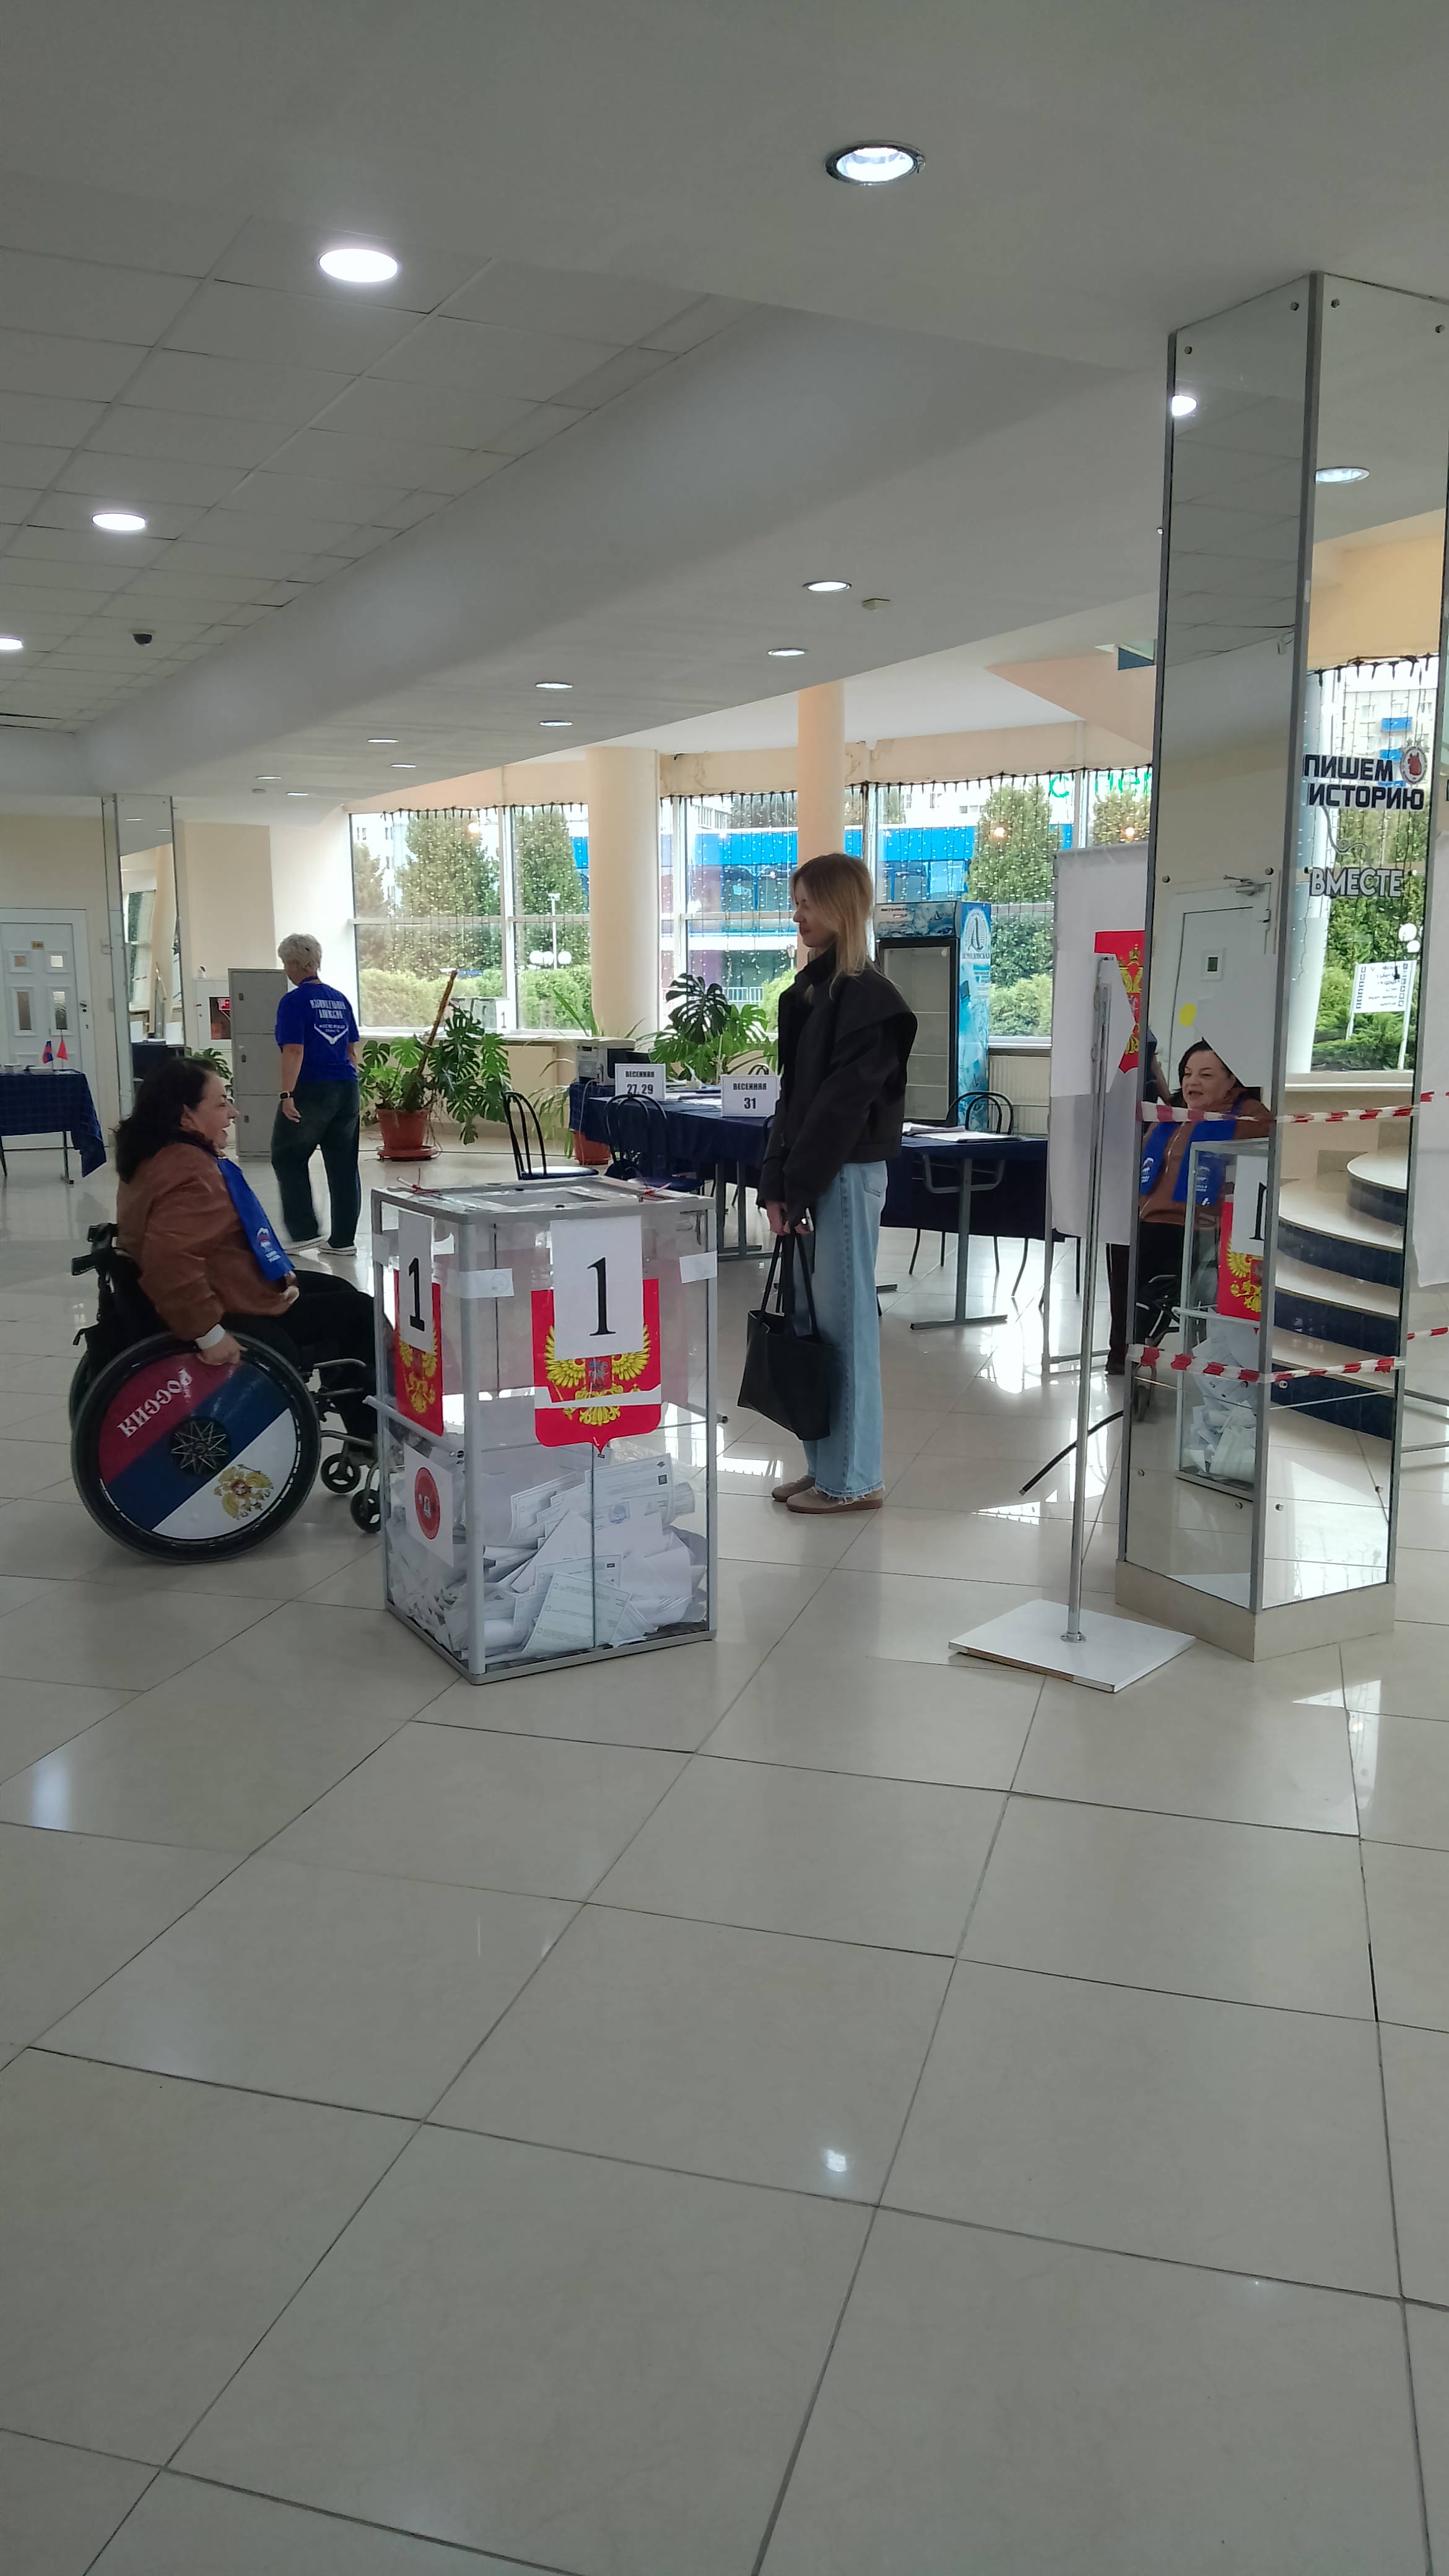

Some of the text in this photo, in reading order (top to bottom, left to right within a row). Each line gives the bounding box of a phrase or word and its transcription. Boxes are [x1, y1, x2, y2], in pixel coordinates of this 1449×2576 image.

[1303, 754, 1393, 782] ПИШЕМ
[1308, 783, 1425, 810] ИСТОРИЮ
[1309, 867, 1404, 897] ВМЕСТЕ
[641, 1084, 653, 1094] 29
[733, 1082, 767, 1090] ВЕСЕННАЯ
[744, 1097, 756, 1109] 31
[409, 1257, 425, 1332] 1
[586, 1256, 617, 1336] 1
